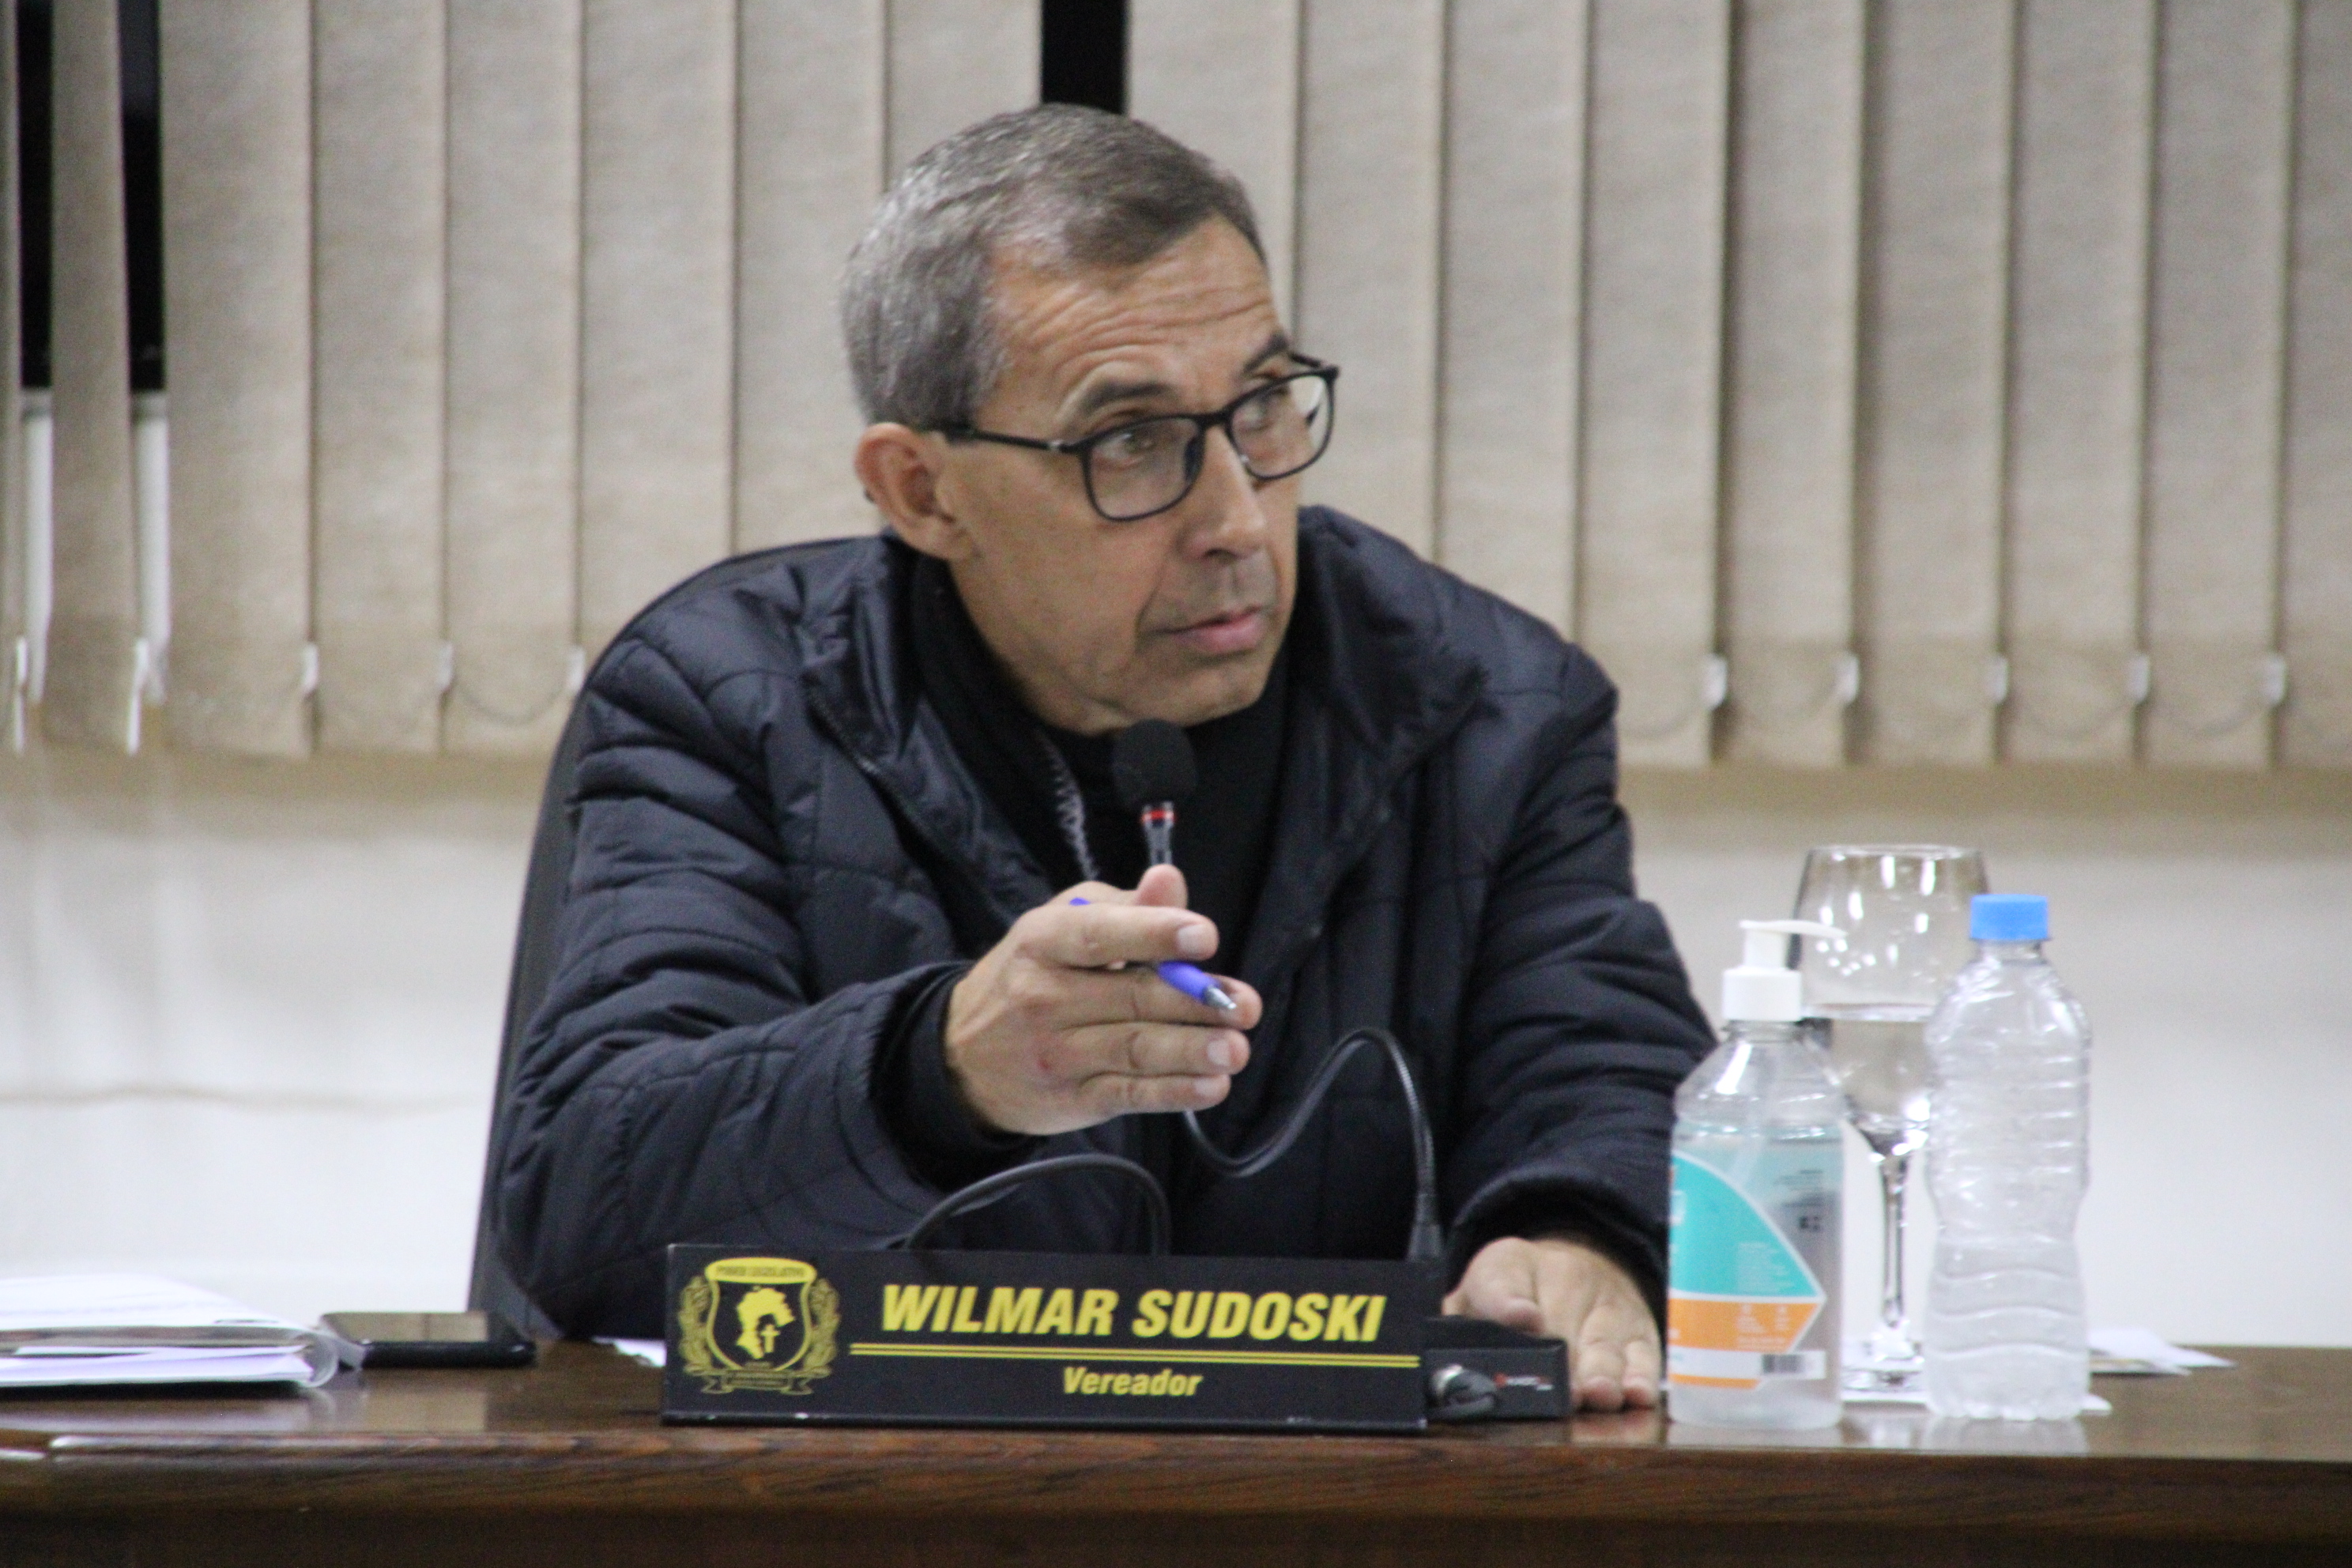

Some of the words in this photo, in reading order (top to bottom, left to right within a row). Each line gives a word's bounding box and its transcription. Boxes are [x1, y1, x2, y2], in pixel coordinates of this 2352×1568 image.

[883, 1284, 1118, 1335] WILMAR
[1133, 1289, 1386, 1341] SUDOSKI
[1064, 1366, 1203, 1396] Vereador
